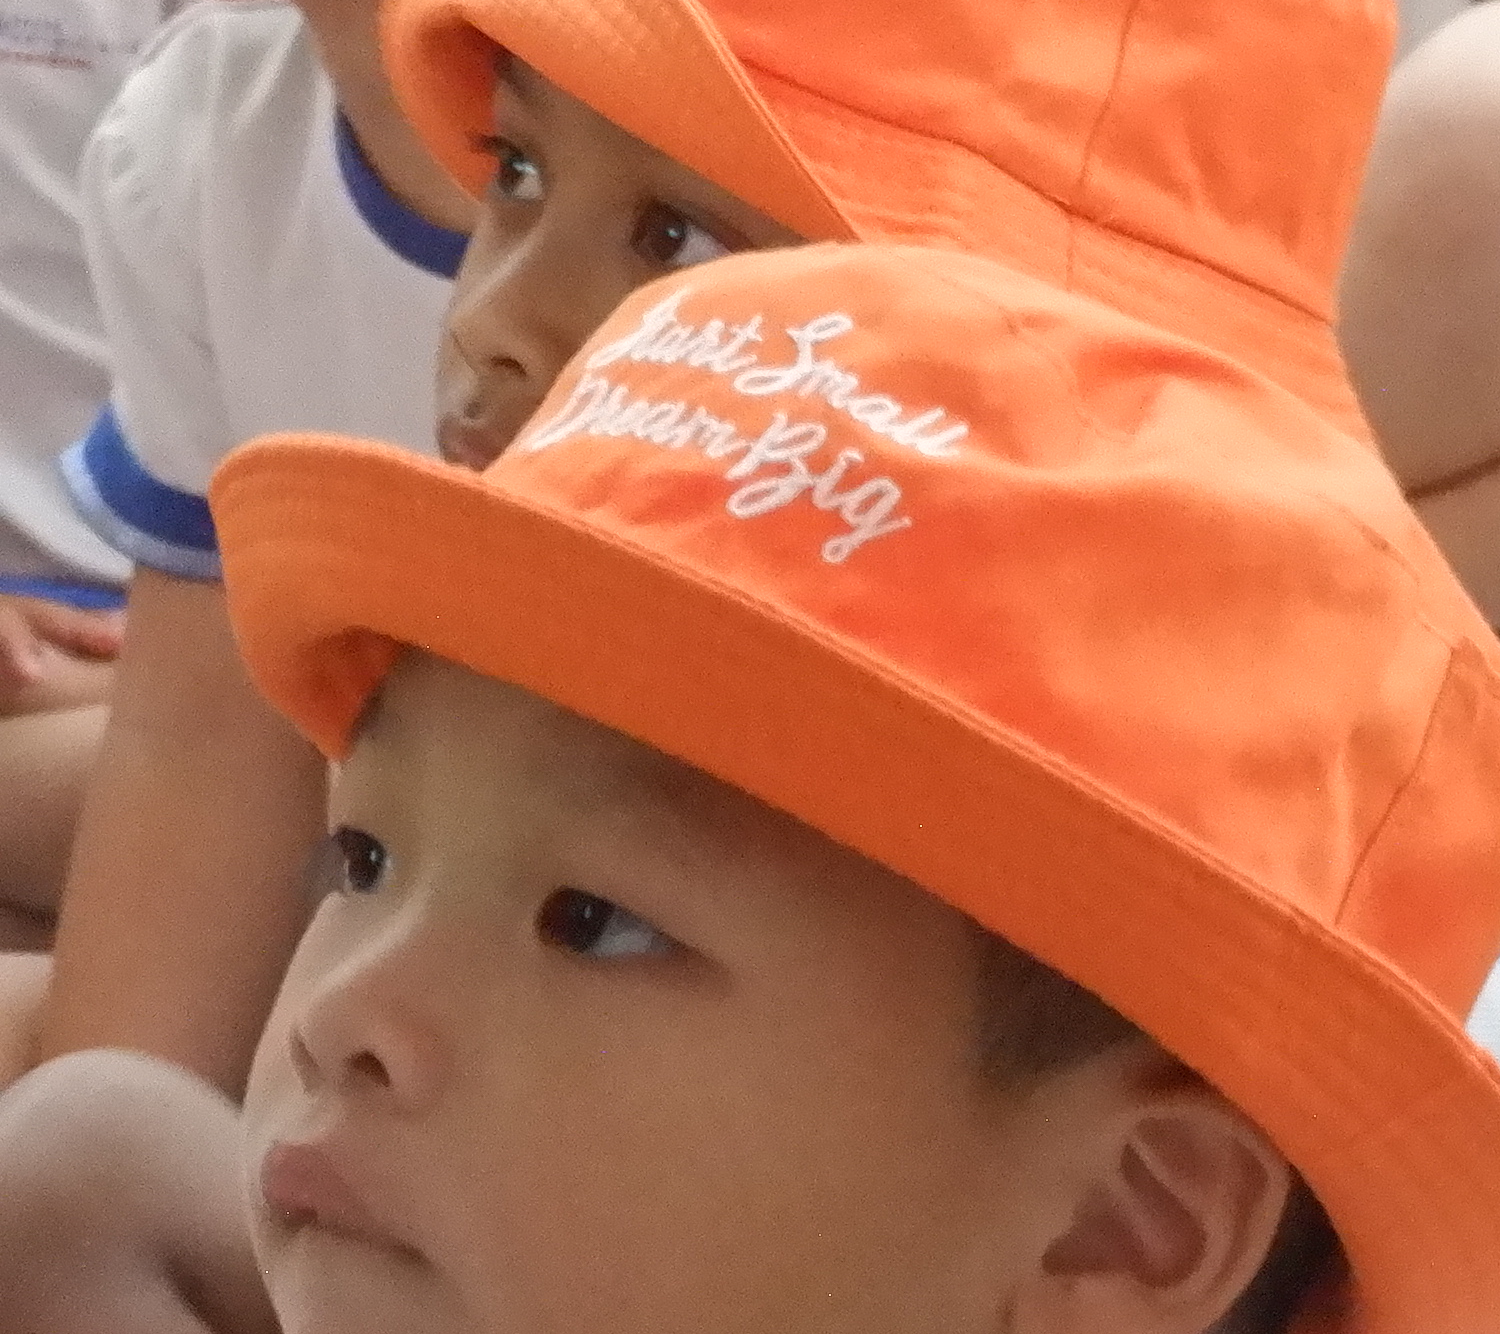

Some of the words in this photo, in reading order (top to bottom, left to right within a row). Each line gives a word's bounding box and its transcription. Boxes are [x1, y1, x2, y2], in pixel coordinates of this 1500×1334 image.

[528, 373, 748, 460] Dream
[724, 411, 912, 564] Big
[732, 312, 968, 457] Small
